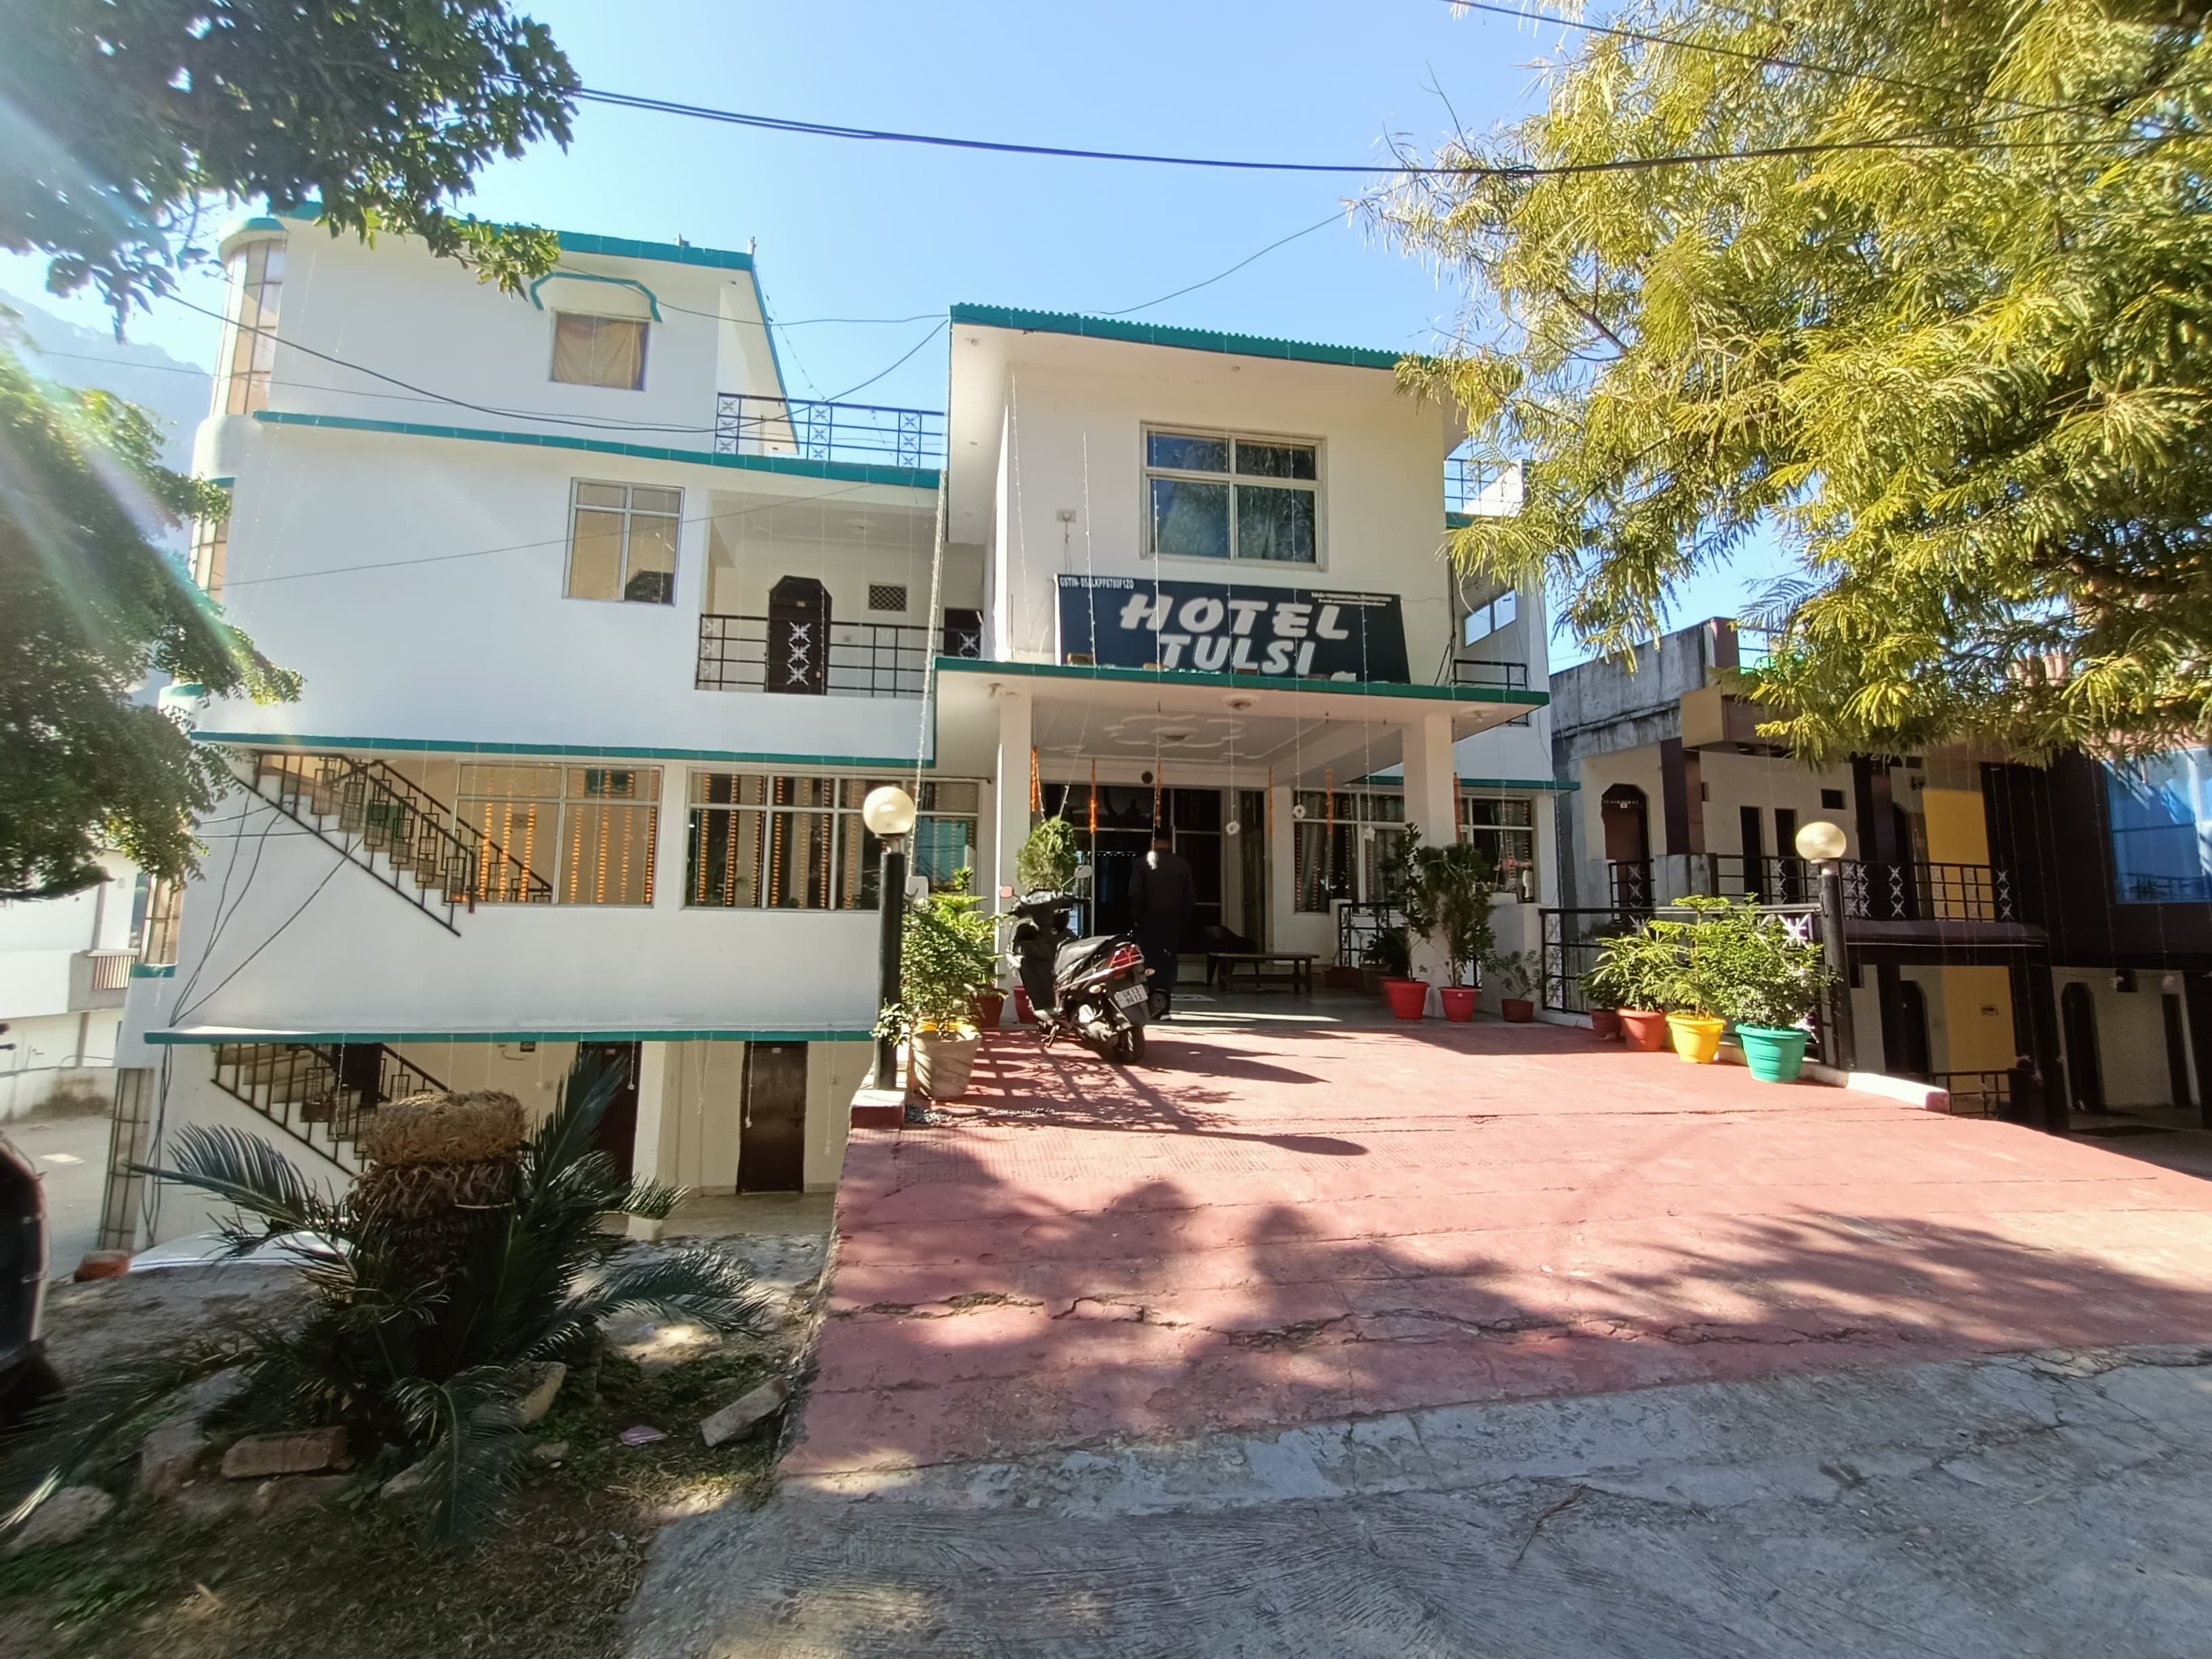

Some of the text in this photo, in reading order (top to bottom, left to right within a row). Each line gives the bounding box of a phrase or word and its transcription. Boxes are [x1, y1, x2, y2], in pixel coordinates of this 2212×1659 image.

[1120, 593, 1349, 640] HOTEL
[1158, 633, 1316, 676] TULSI
[1122, 987, 1139, 998] UK13
